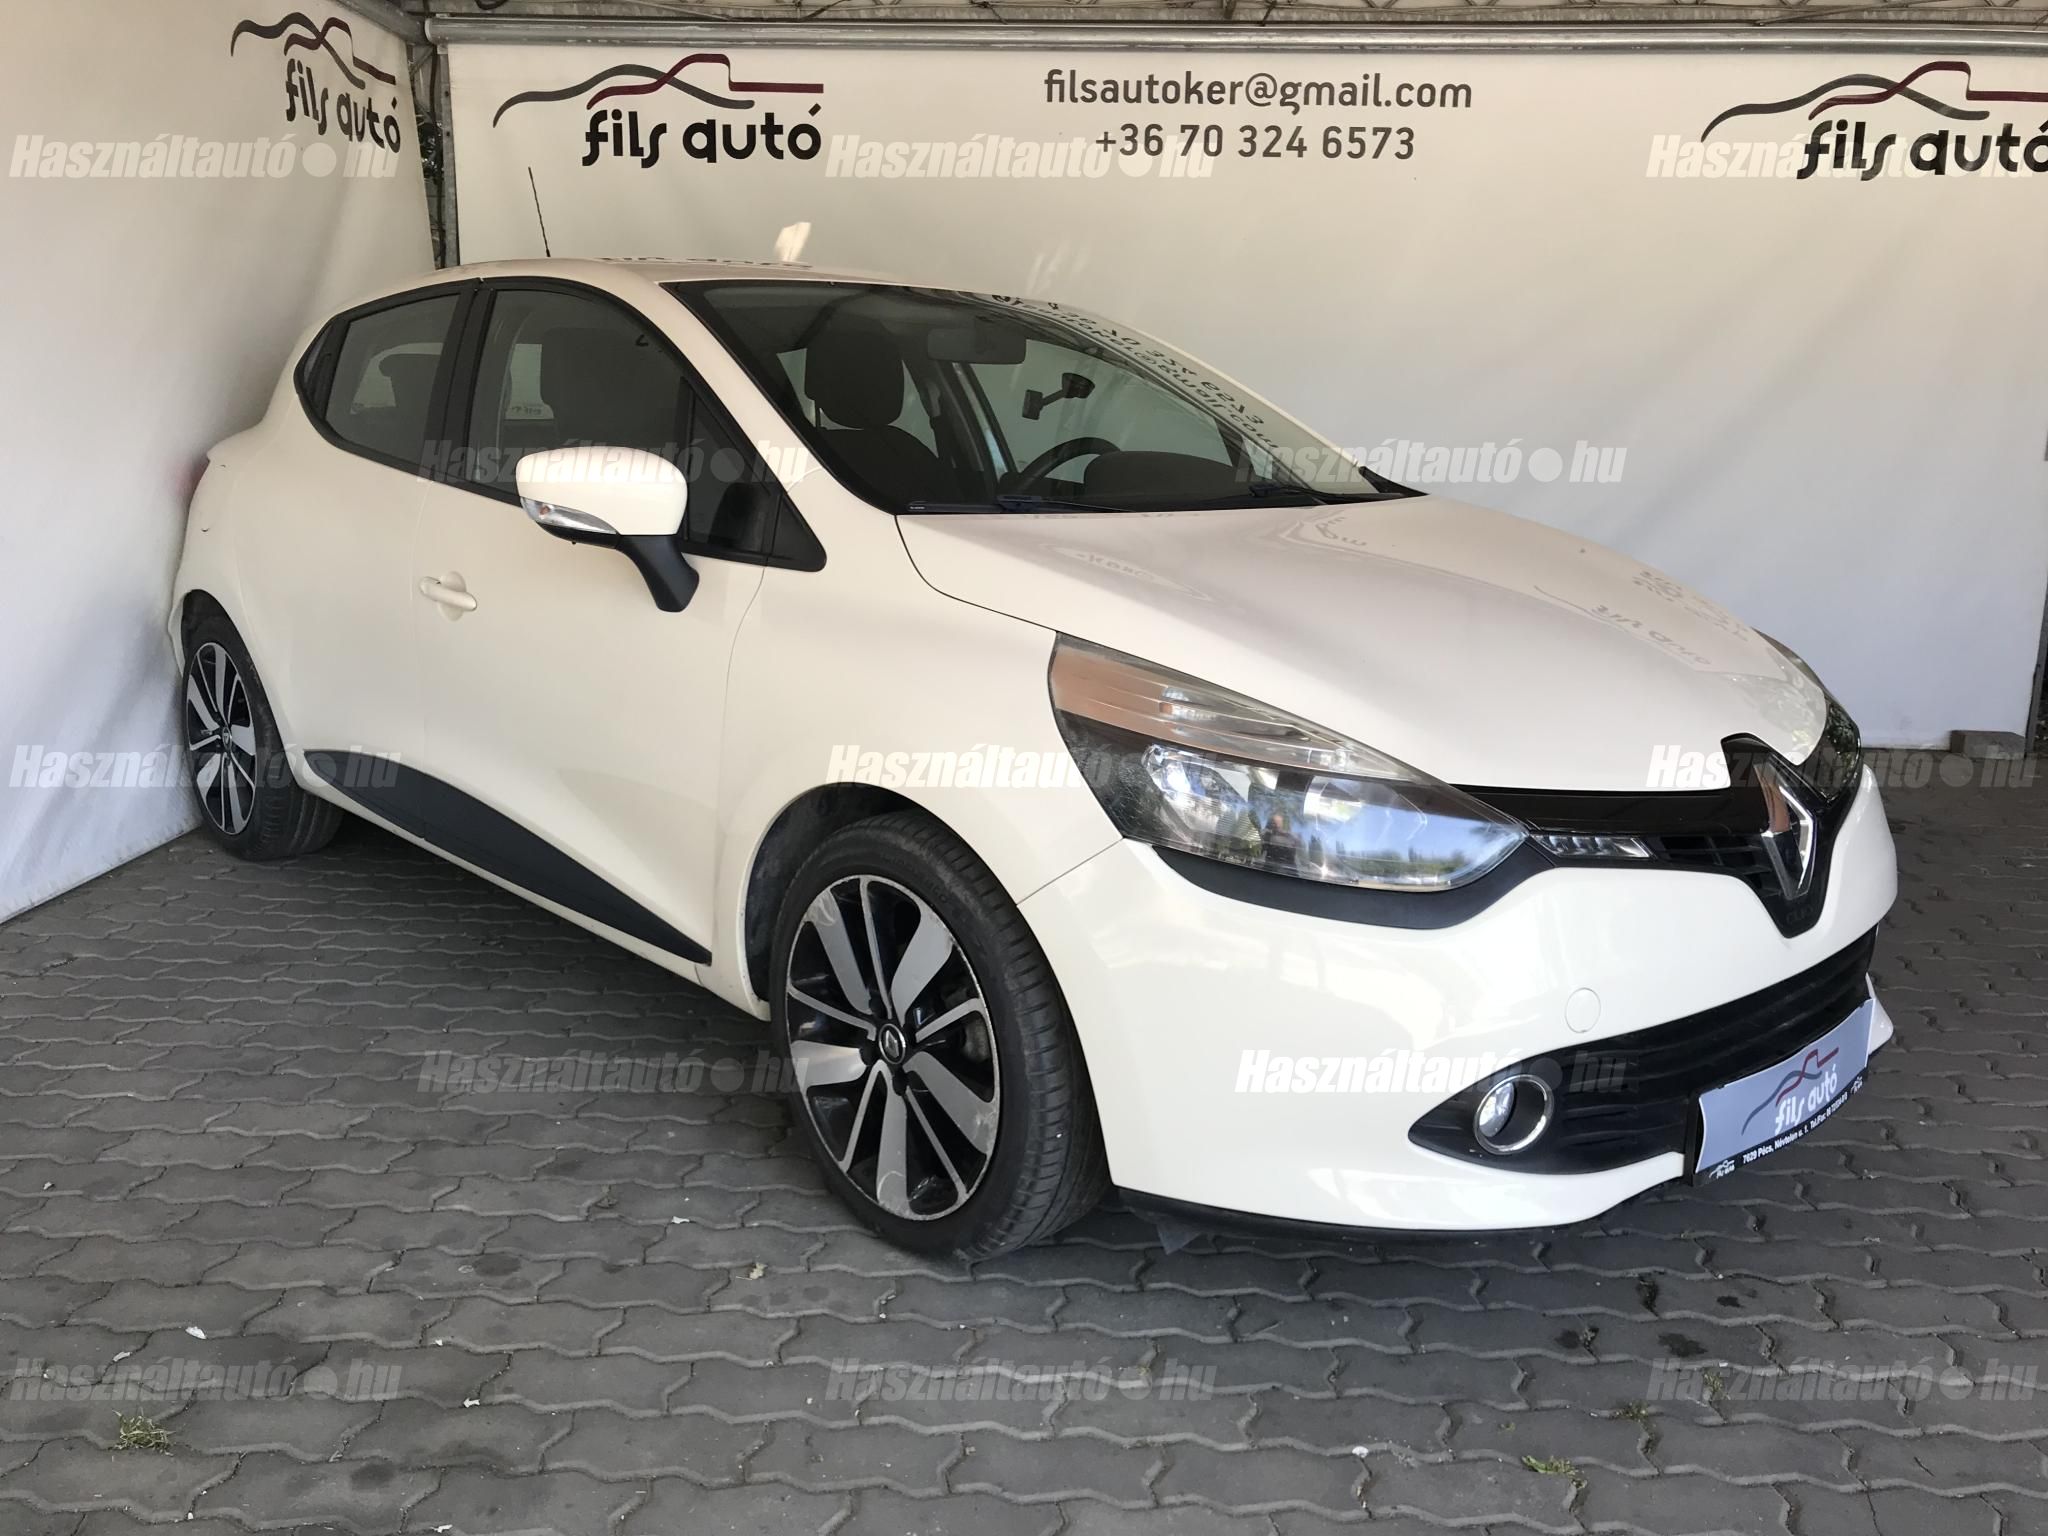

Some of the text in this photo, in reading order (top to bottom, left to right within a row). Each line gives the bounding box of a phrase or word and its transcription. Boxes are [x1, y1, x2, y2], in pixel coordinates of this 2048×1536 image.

[285, 58, 401, 154] fils autó
[1044, 68, 1472, 116] filsautoker@gmail.com
[581, 103, 822, 169] fils autó
[1095, 123, 1415, 160] +36 70 324 6573
[1796, 118, 1897, 181] fils
[1775, 1096, 1805, 1136] fils
[1808, 1063, 1838, 1112] autó
